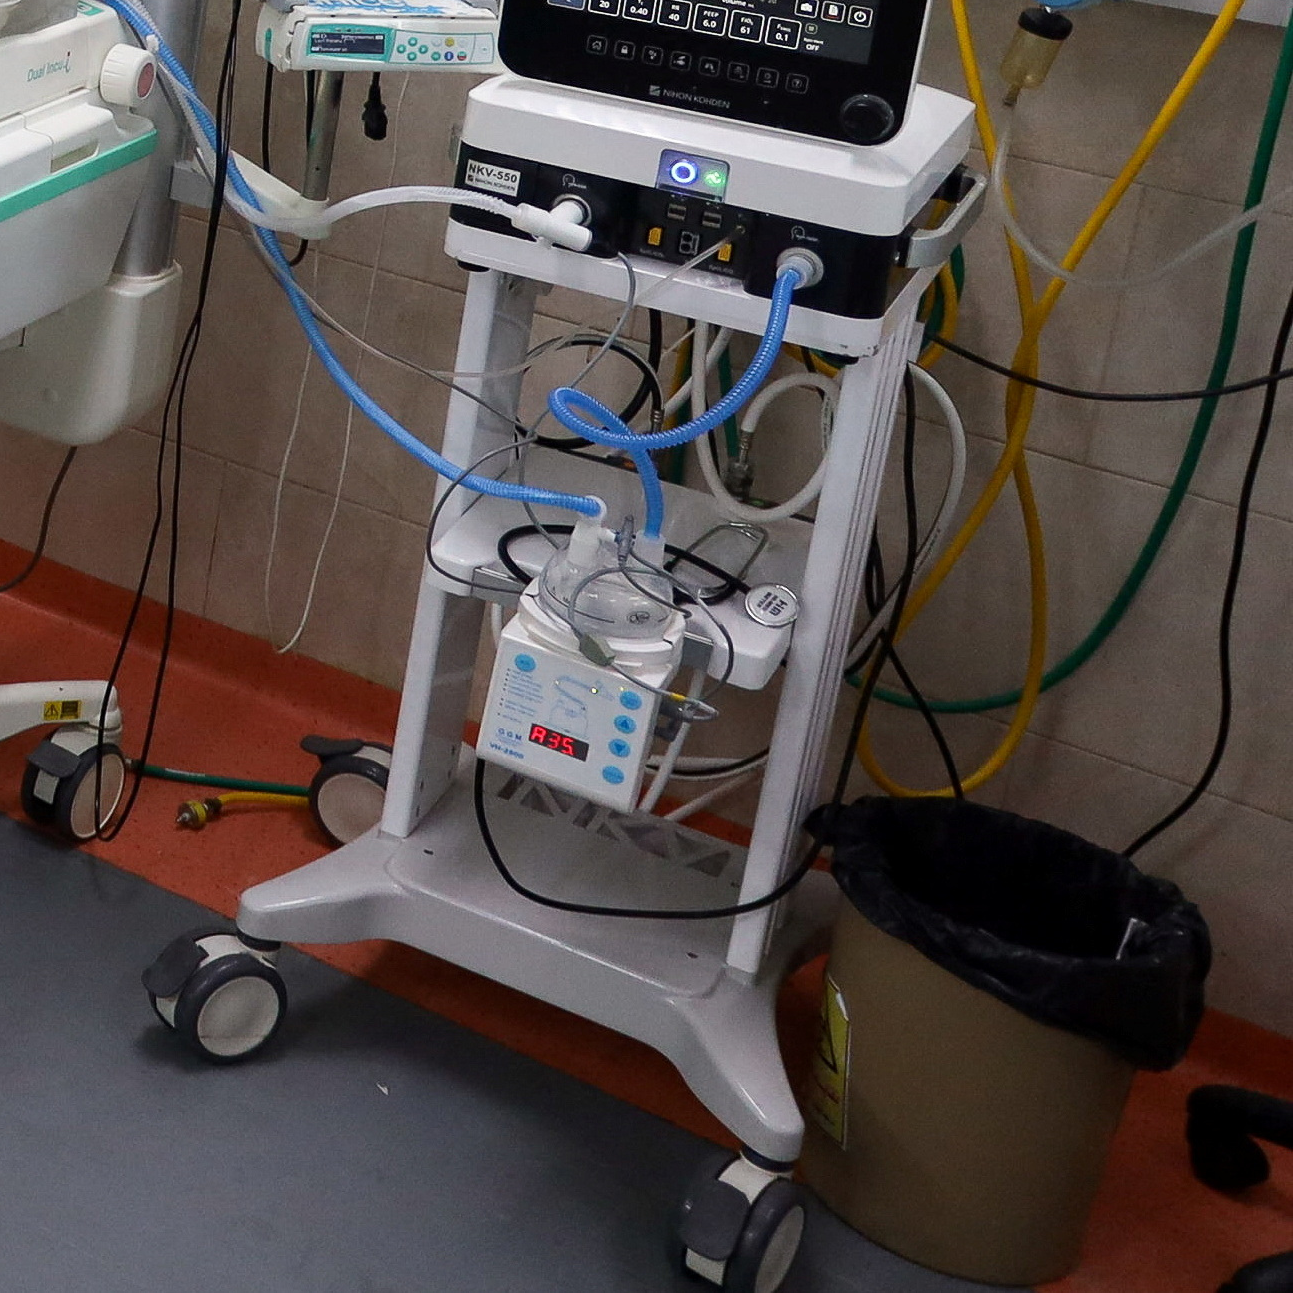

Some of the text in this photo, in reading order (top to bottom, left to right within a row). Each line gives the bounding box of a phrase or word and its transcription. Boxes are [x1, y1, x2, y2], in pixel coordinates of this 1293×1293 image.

[598, 0, 610, 9] 20
[630, 6, 649, 16] 0.40
[668, 13, 680, 22] 40
[702, 19, 717, 28] 6.0
[740, 26, 751, 35] 61
[776, 33, 789, 42] 0.1
[27, 64, 46, 82] Dual
[663, 89, 730, 109] NIHON KOHDEN
[468, 163, 518, 183] NKV-550
[475, 178, 516, 191] NIHON KOHDEN
